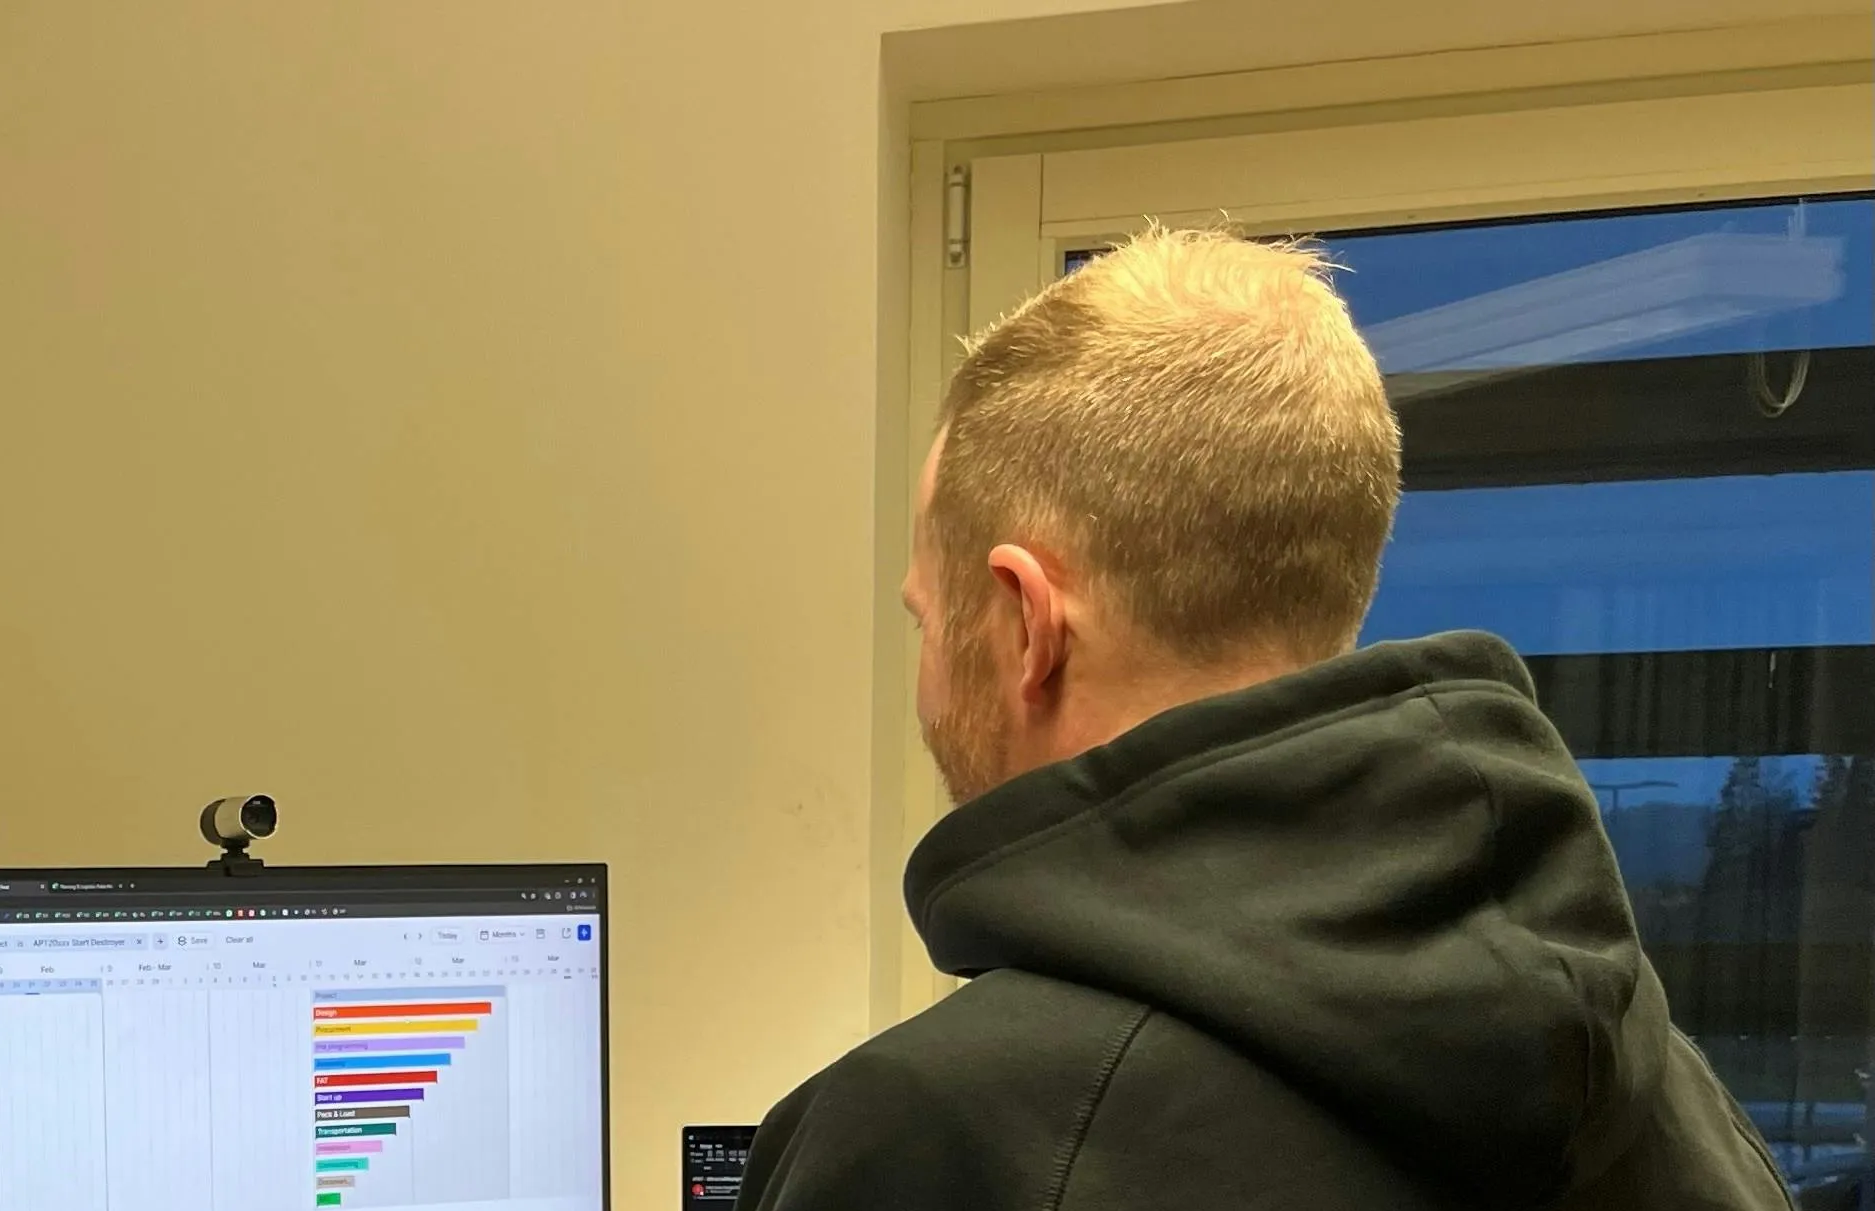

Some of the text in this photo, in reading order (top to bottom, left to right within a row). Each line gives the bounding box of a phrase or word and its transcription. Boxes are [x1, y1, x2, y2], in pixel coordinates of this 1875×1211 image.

[72, 938, 89, 947] Start
[225, 936, 244, 944] Clear
[252, 961, 266, 969] Mar
[315, 1009, 337, 1018] Design
